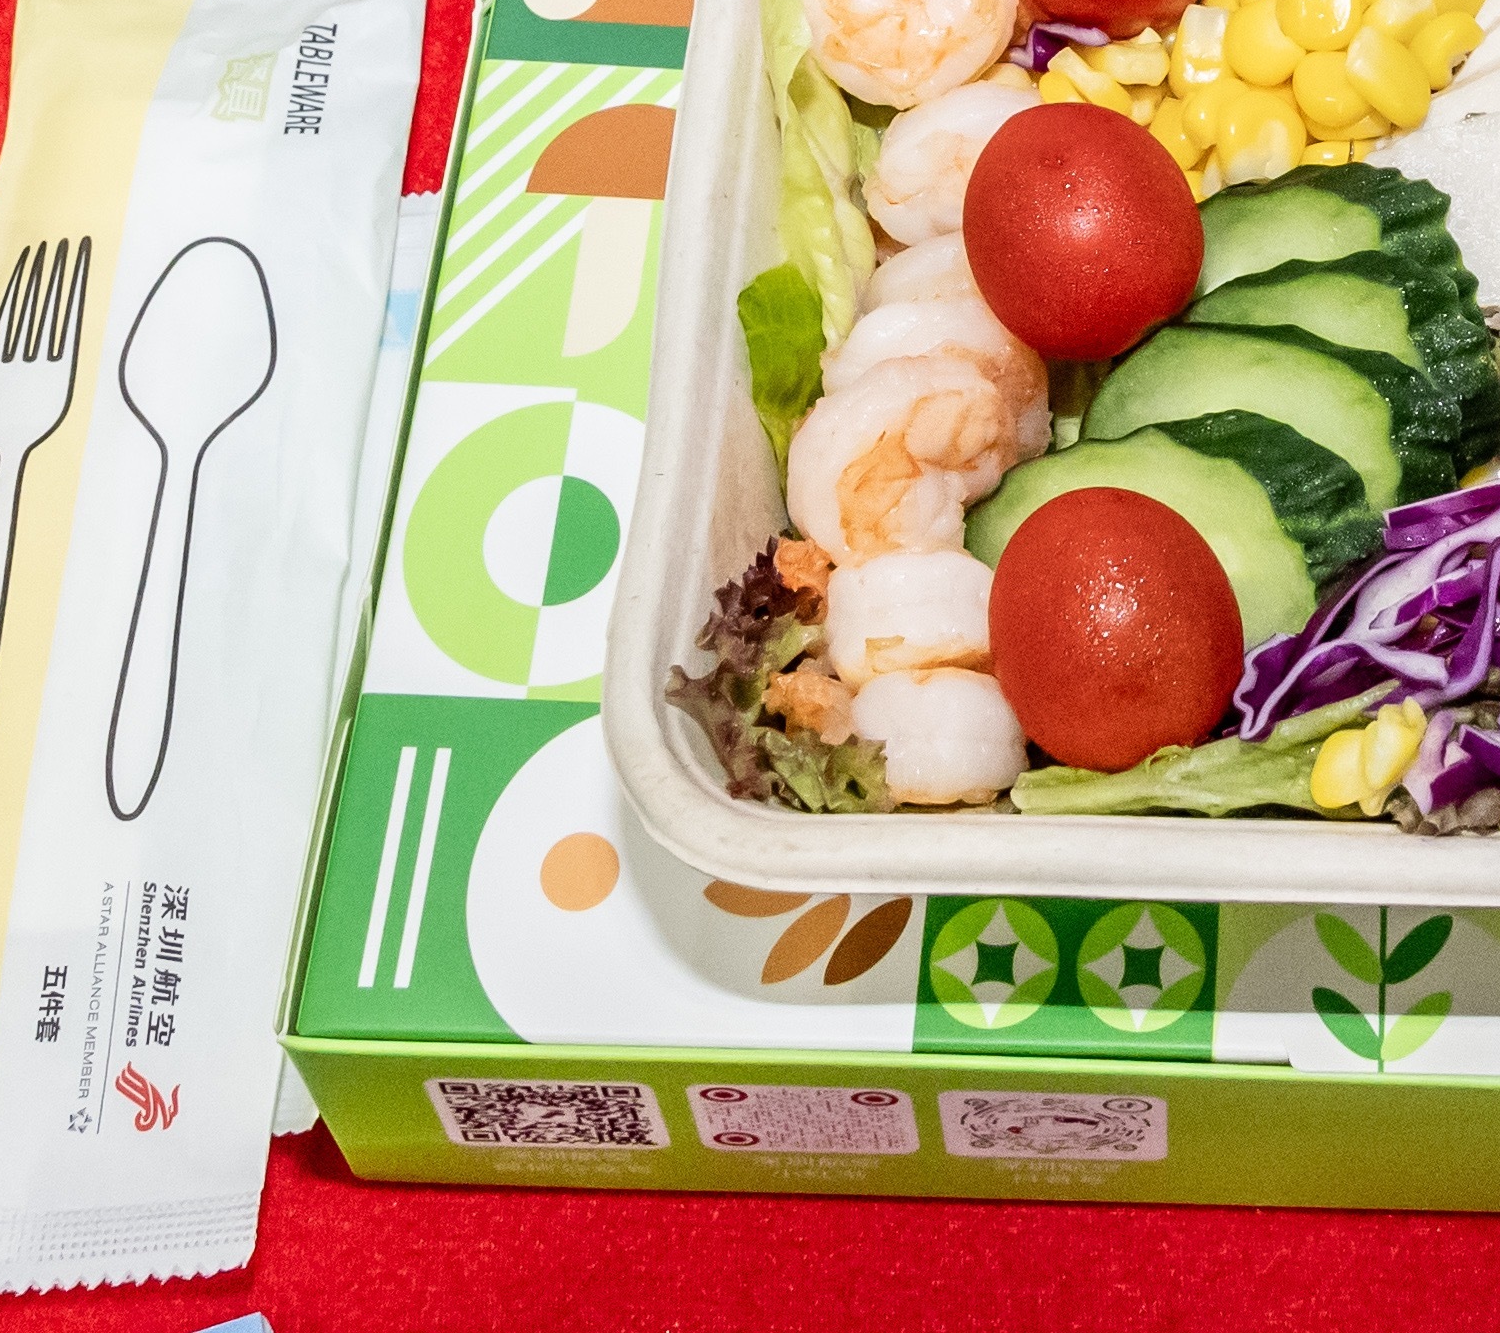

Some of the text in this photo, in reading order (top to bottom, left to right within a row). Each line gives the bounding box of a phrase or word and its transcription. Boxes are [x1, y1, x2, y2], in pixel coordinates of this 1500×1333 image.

[283, 23, 338, 135] TABLEWARE
[35, 965, 68, 1043] 五件套
[78, 881, 114, 1100] A STAR ALLIANCE MEMBER
[125, 881, 157, 1048] Shenzhen Airlines
[145, 884, 190, 1047] 深圳航空
